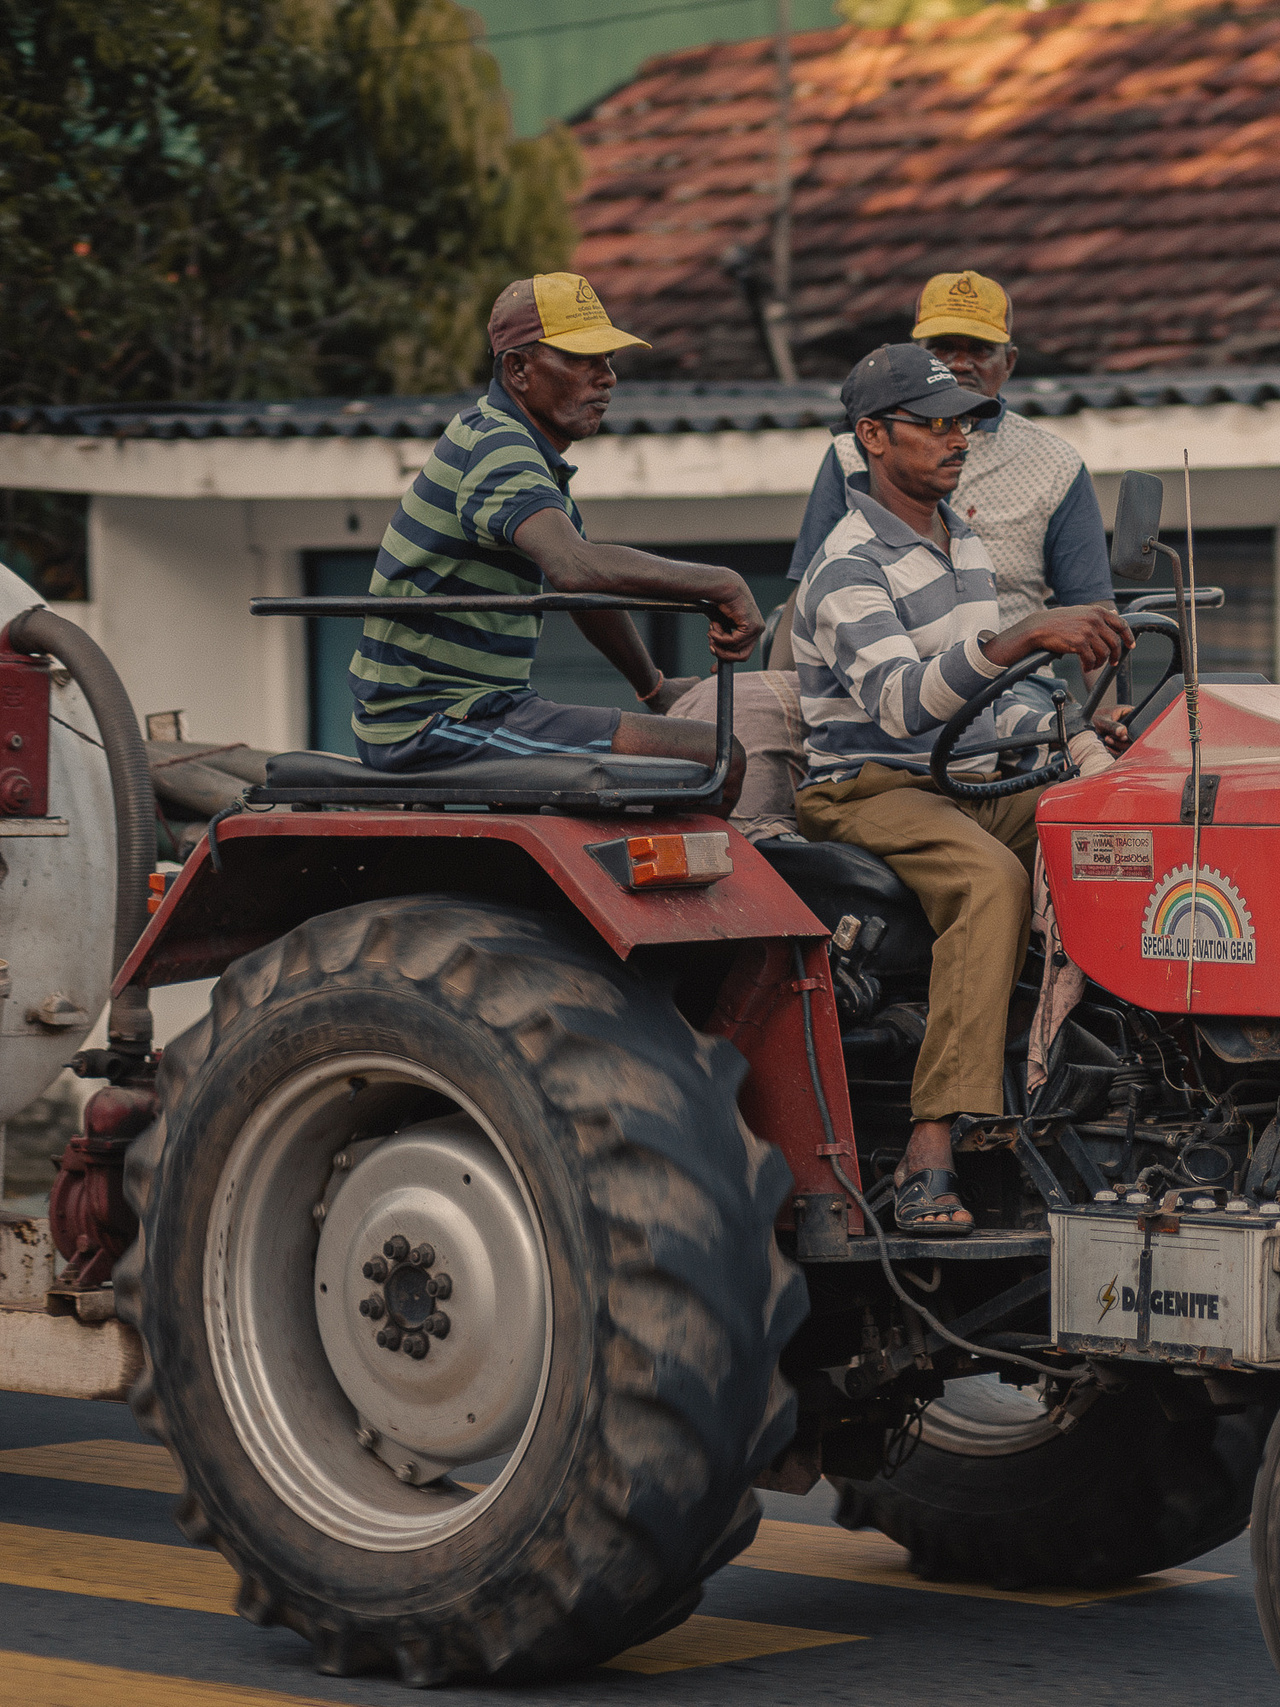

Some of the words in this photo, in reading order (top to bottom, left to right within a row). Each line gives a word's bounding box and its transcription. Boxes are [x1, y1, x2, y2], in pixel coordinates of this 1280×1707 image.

[1115, 838, 1149, 848] TRACTORS
[1143, 935, 1175, 956] SPECIAL
[1230, 941, 1253, 961] GEAR
